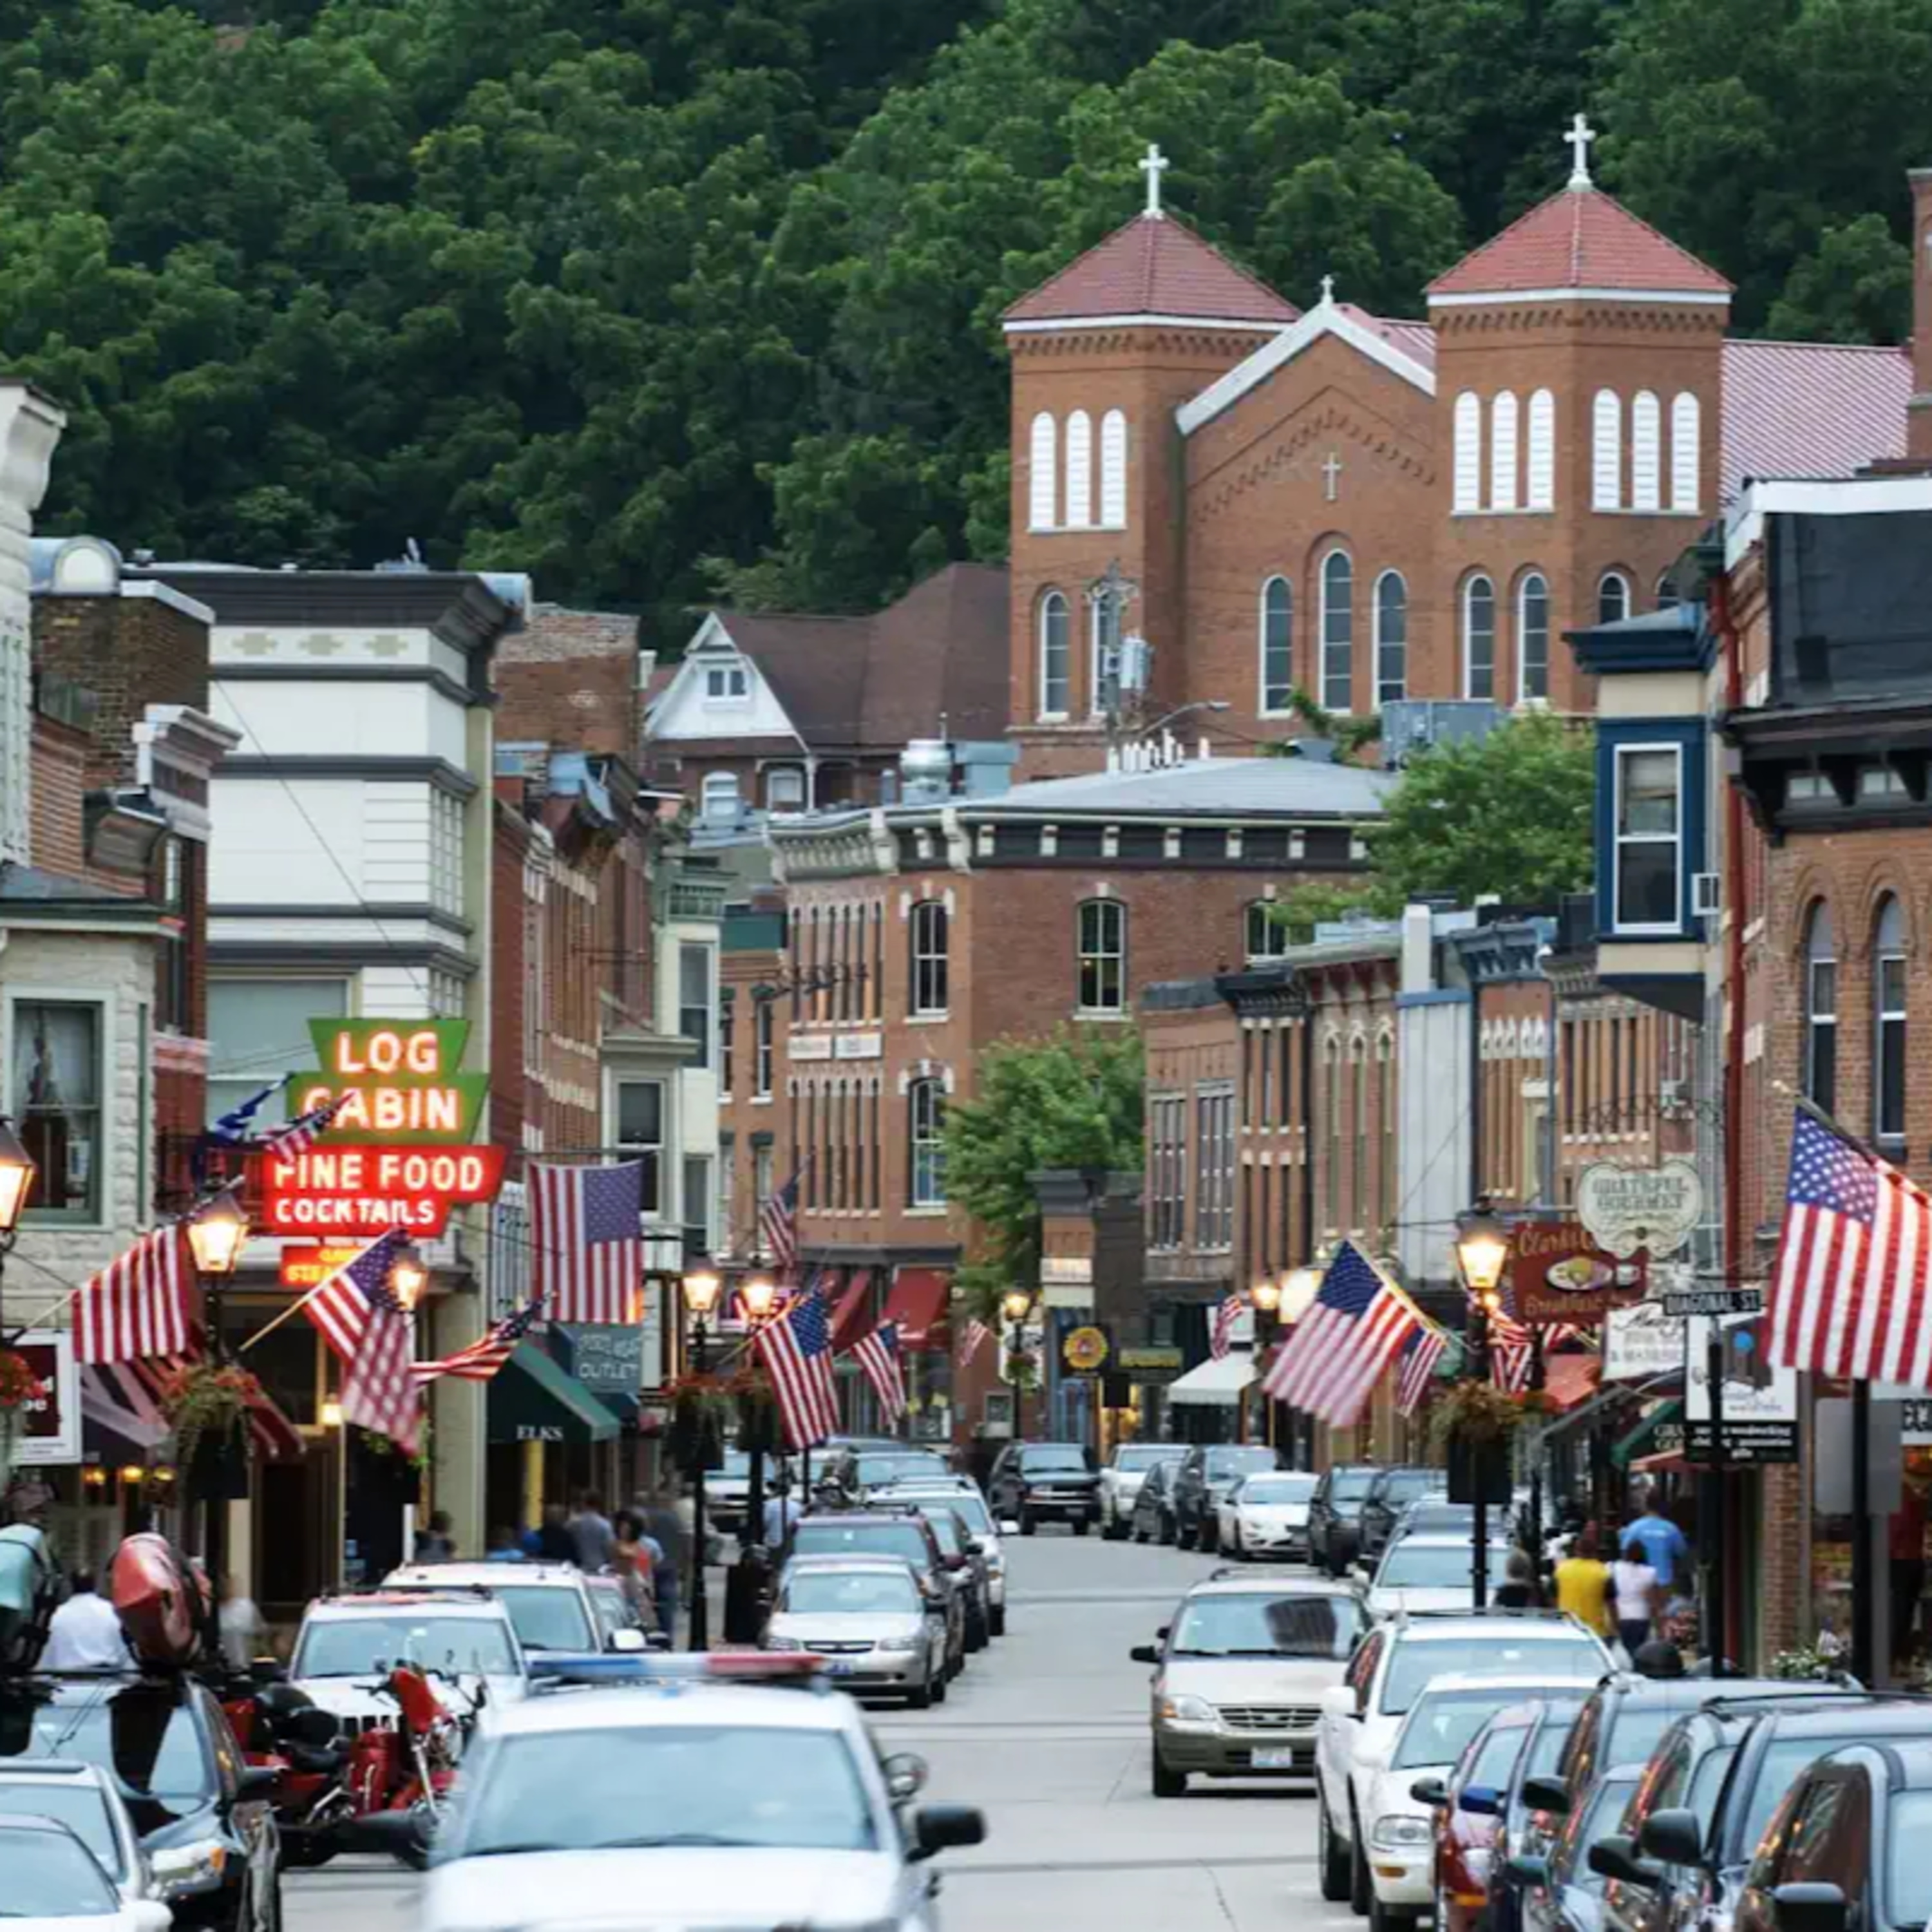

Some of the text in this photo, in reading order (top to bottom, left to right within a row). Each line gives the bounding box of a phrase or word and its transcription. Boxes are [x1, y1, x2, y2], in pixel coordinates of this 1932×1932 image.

[337, 1031, 439, 1073] LOG
[303, 1086, 459, 1130] CABIN
[274, 1154, 484, 1191] FINE FOOD
[1593, 1177, 1690, 1194] GRATEFUL
[276, 1198, 435, 1224] COCKTAILS
[1667, 1294, 1735, 1314] DIAGONAL
[580, 1362, 638, 1379] OUTLET
[516, 1425, 564, 1441] ELKS
